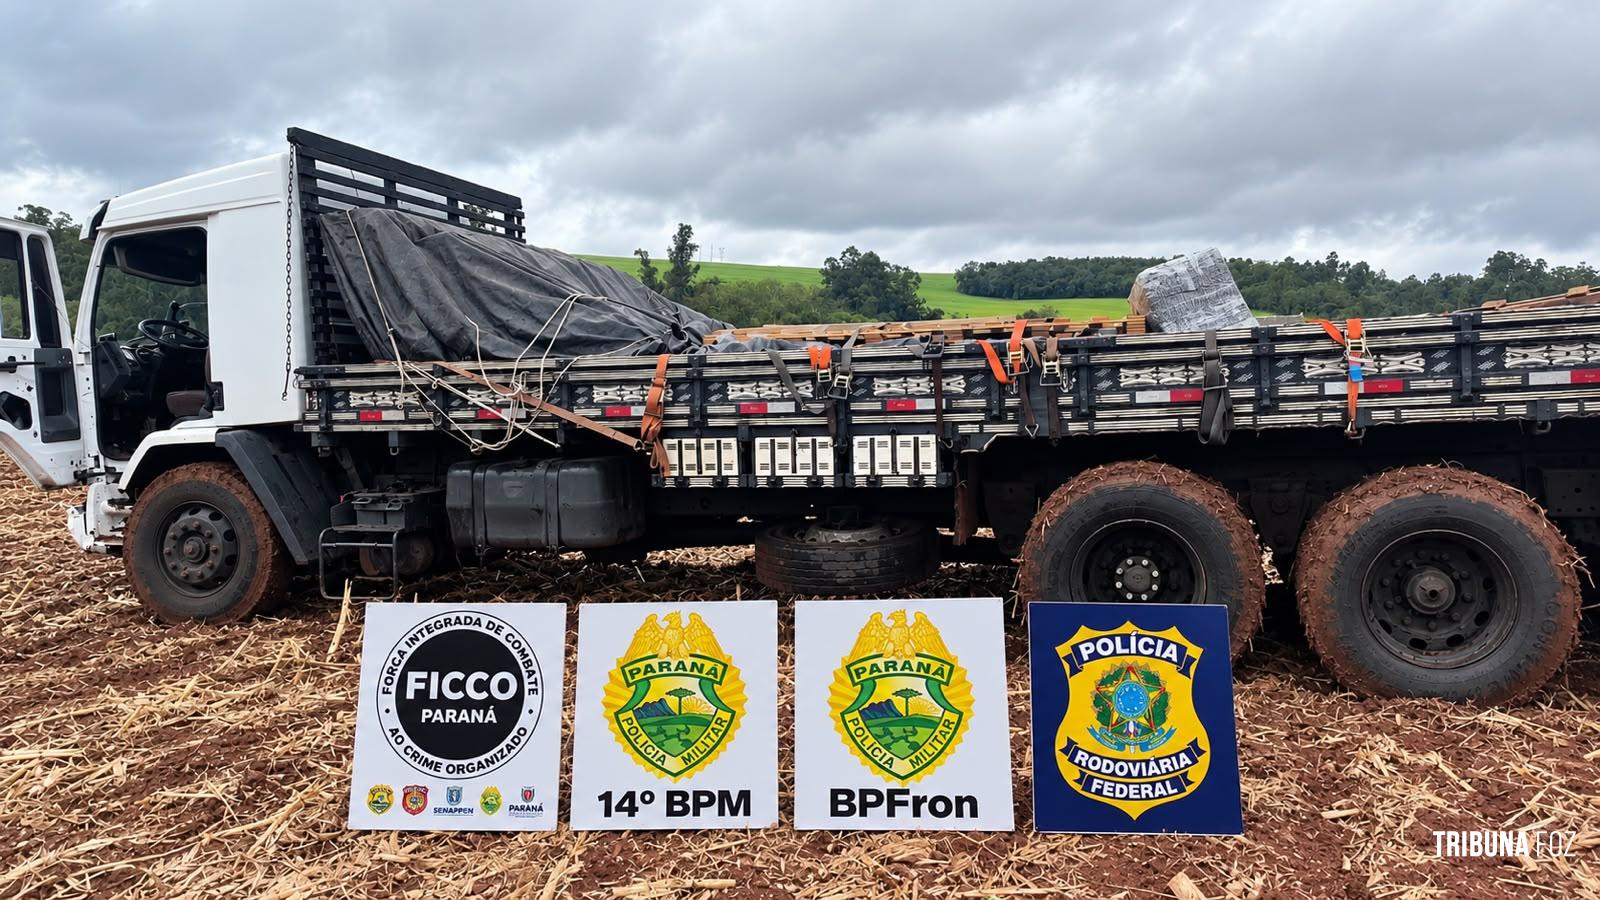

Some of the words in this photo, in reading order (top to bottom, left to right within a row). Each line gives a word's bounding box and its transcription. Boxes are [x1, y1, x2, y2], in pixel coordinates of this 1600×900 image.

[404, 615, 482, 648] INTEGRADA
[485, 620, 504, 637] DE
[504, 632, 539, 696] COMBATE
[1078, 630, 1178, 663] POLÍCIA
[627, 660, 719, 681] PARANÁ
[852, 660, 946, 680] PARANÁ
[405, 671, 518, 701] FICCO
[421, 705, 497, 724] PARANÁ
[388, 726, 404, 746] AO
[403, 745, 443, 773] CRIME
[445, 726, 528, 775] ORGANIZADO
[681, 717, 728, 767] MILITAR
[909, 718, 956, 770] MILITAR
[1073, 750, 1192, 777] RODOVIÁRIA
[665, 789, 751, 817] BPM
[829, 788, 979, 818] BPFron
[1090, 778, 1178, 799] FEDERAL
[508, 803, 544, 813] PARANÁ
